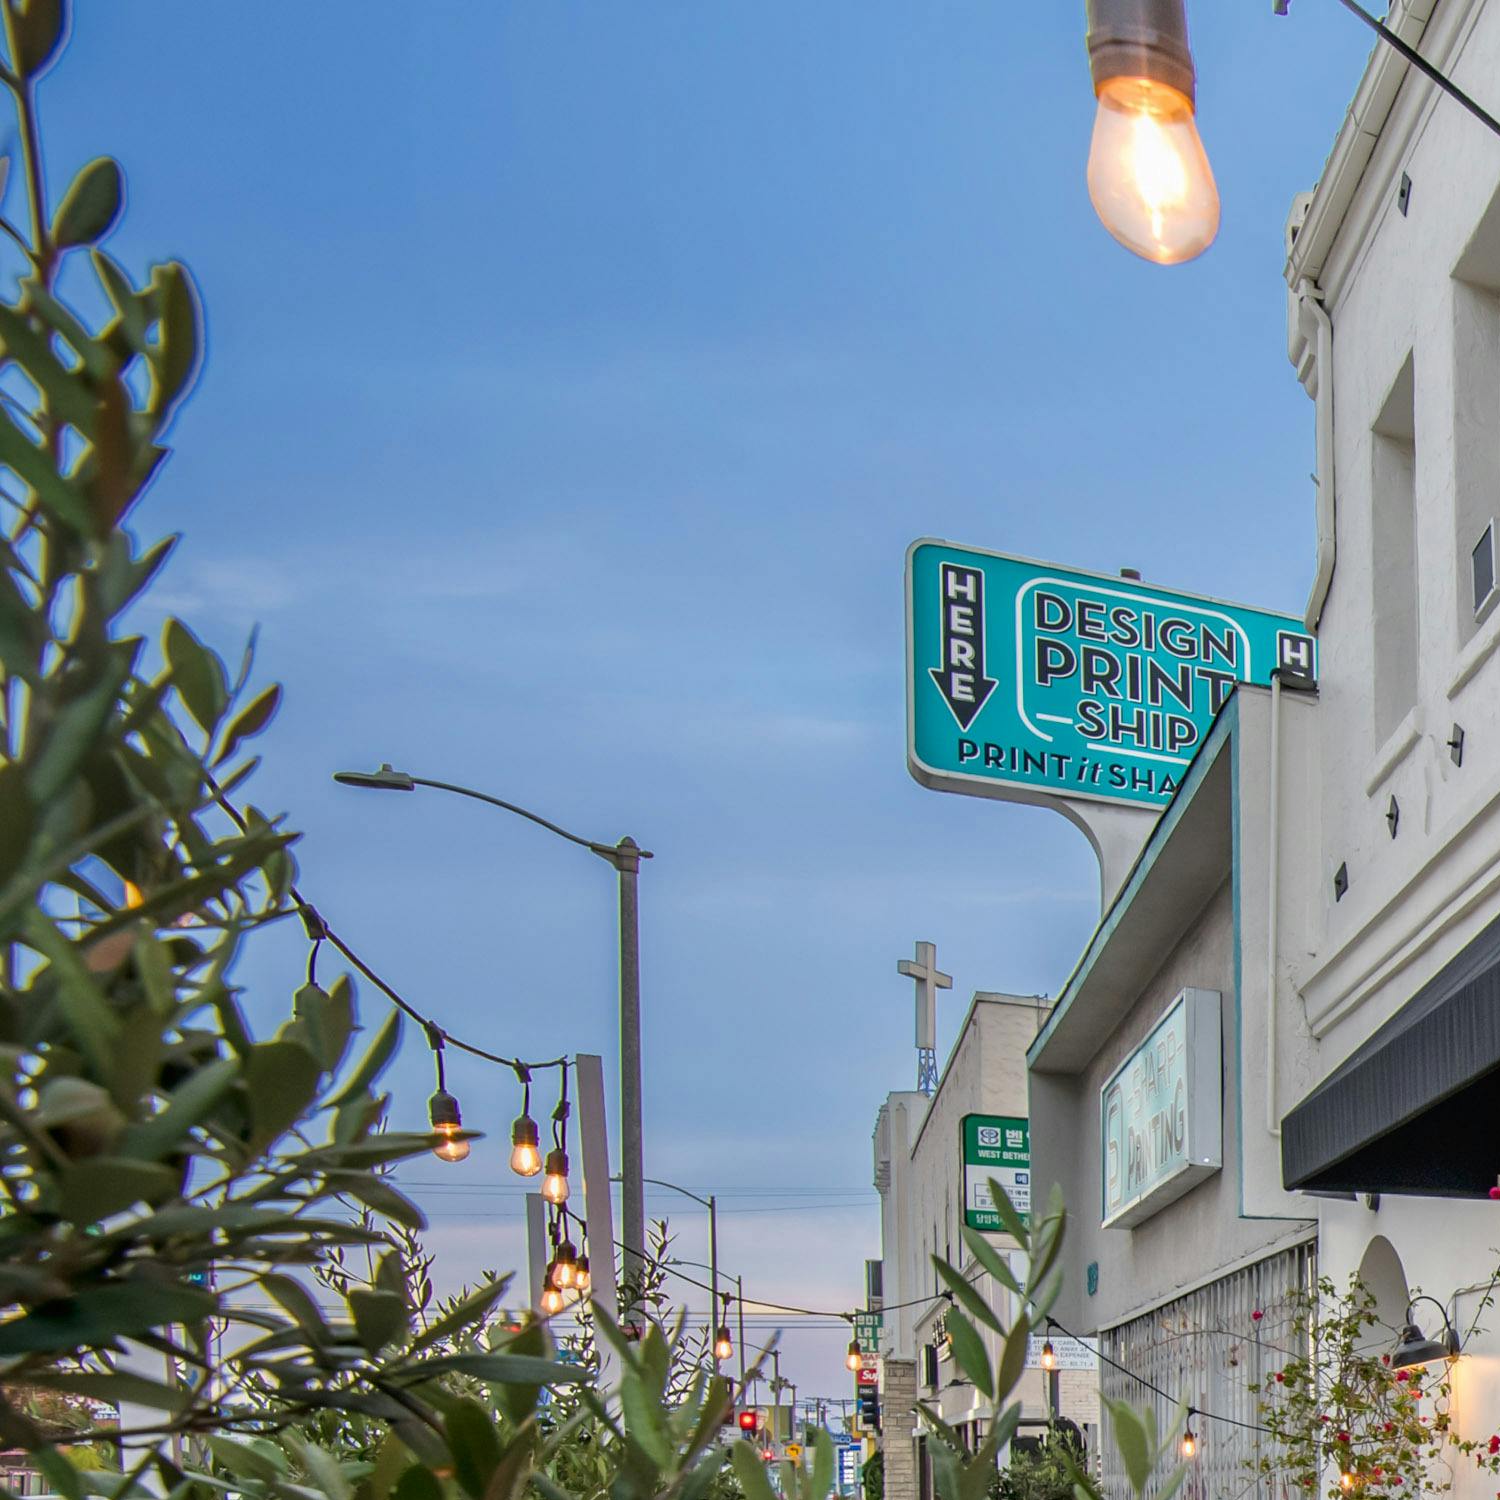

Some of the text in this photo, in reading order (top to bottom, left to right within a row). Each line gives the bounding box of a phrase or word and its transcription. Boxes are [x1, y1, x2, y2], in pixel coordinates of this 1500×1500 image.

[947, 570, 976, 703] HERE
[1034, 590, 1236, 668] DESIGN
[1035, 636, 1236, 716] PRINT
[1074, 698, 1199, 753] SHIP
[958, 738, 1073, 780] PRINT
[977, 1150, 1000, 1159] WEST
